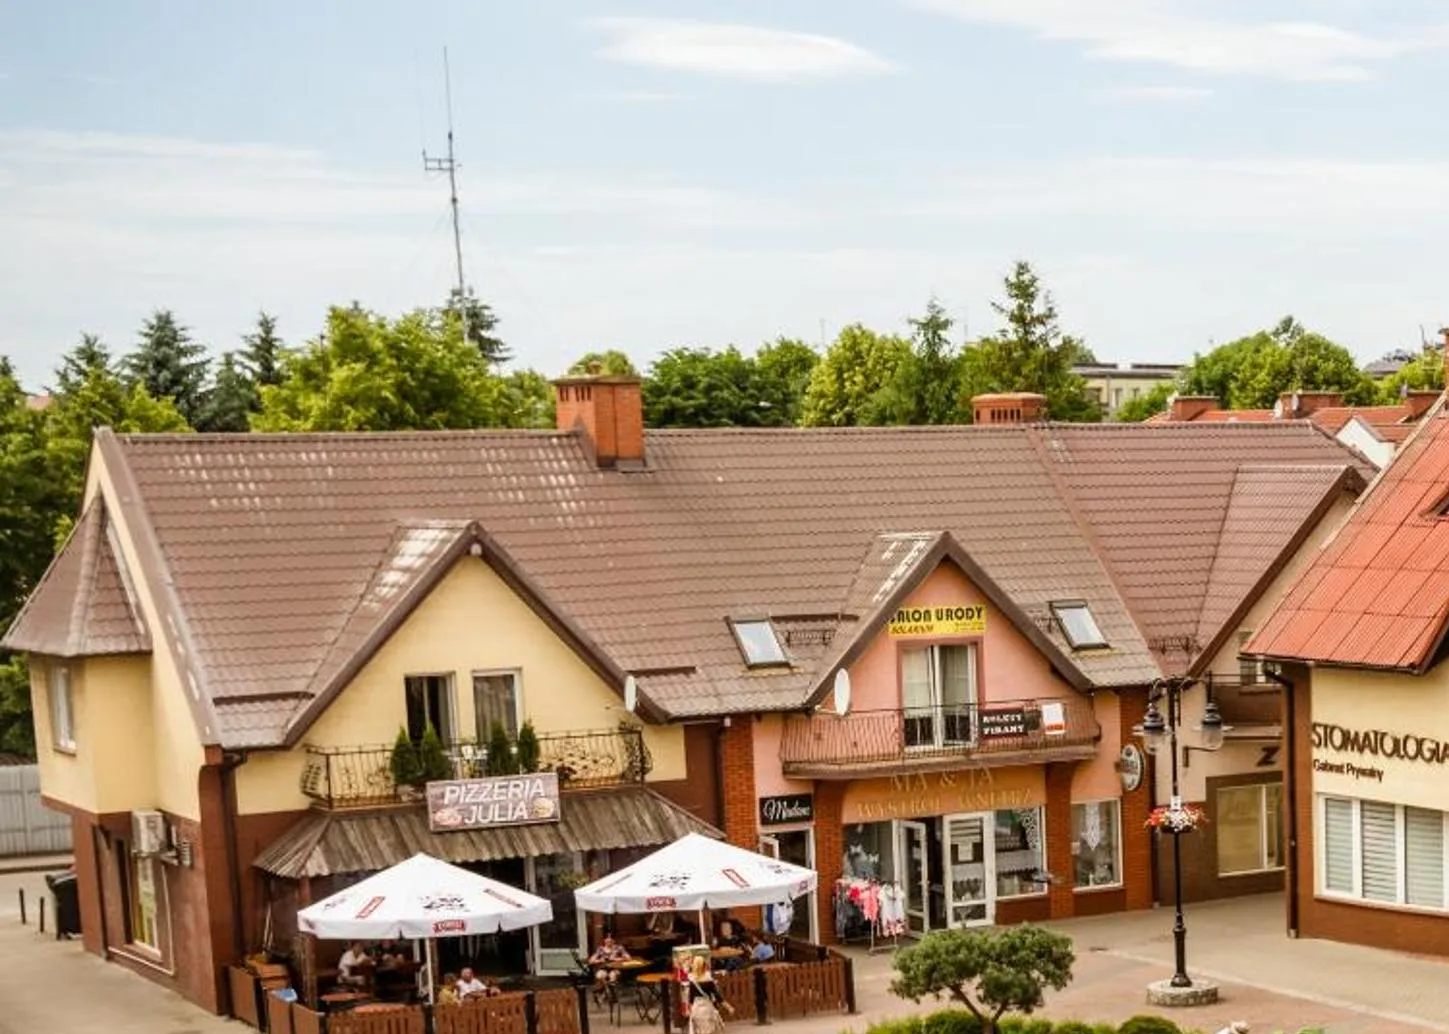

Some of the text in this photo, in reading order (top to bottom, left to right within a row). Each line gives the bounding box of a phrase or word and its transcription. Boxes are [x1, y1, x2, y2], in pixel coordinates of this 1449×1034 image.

[934, 606, 982, 621] URODY
[1346, 763, 1384, 783] Prywatny
[444, 778, 545, 804] PIZZERIA
[464, 801, 528, 824] JULIA
